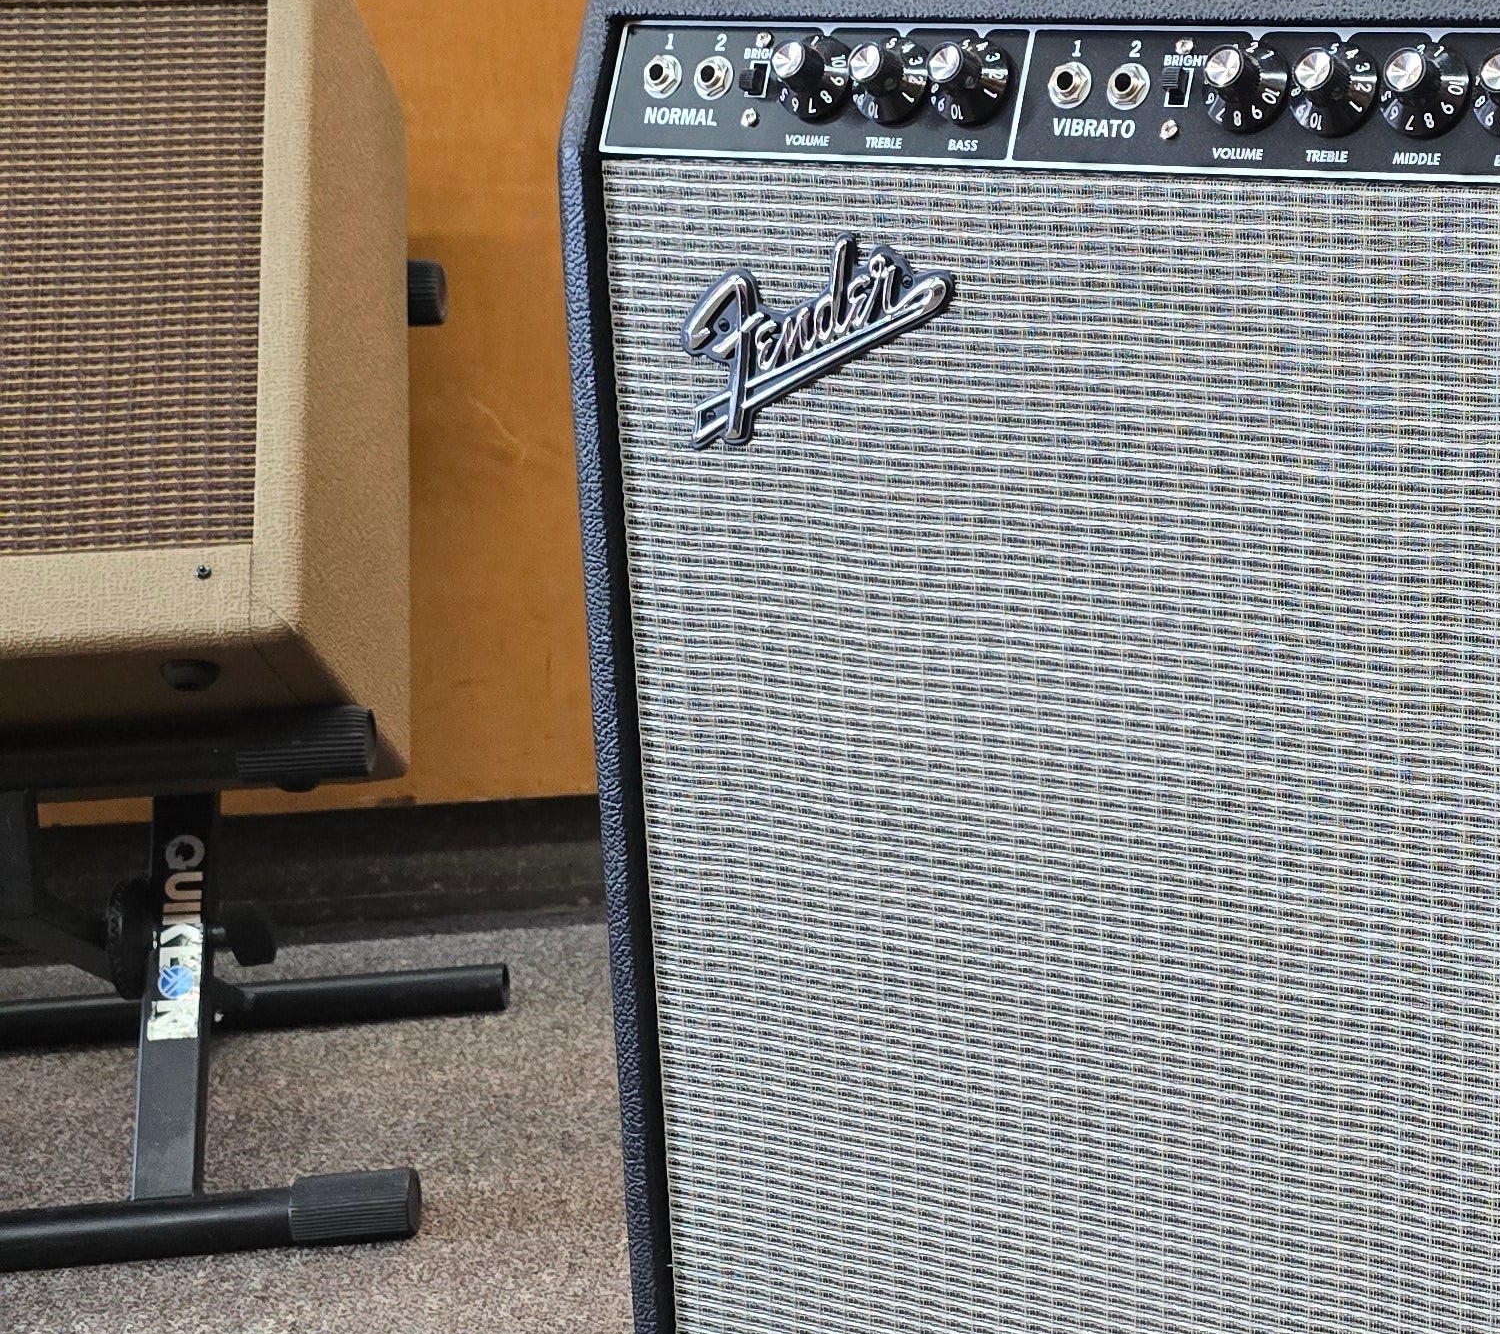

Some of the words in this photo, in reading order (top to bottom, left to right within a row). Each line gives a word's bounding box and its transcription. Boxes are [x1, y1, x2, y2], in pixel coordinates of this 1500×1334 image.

[664, 33, 674, 50] 1
[715, 34, 728, 51] 2
[1072, 40, 1081, 57] 1
[1129, 40, 1142, 58] 2
[1164, 55, 1208, 67] BRIGHT
[820, 90, 832, 103] 8
[644, 107, 717, 126] NORMAL
[1424, 113, 1434, 128] 8
[1053, 118, 1136, 138] VIBRATO
[785, 134, 830, 147] VOLUME
[866, 137, 902, 149] TREBLE
[948, 139, 978, 151] BASS
[1212, 147, 1263, 160] VOLUME
[1305, 149, 1349, 163] TREBLE
[1393, 152, 1441, 165] MIDDLE
[684, 235, 953, 446] Fender
